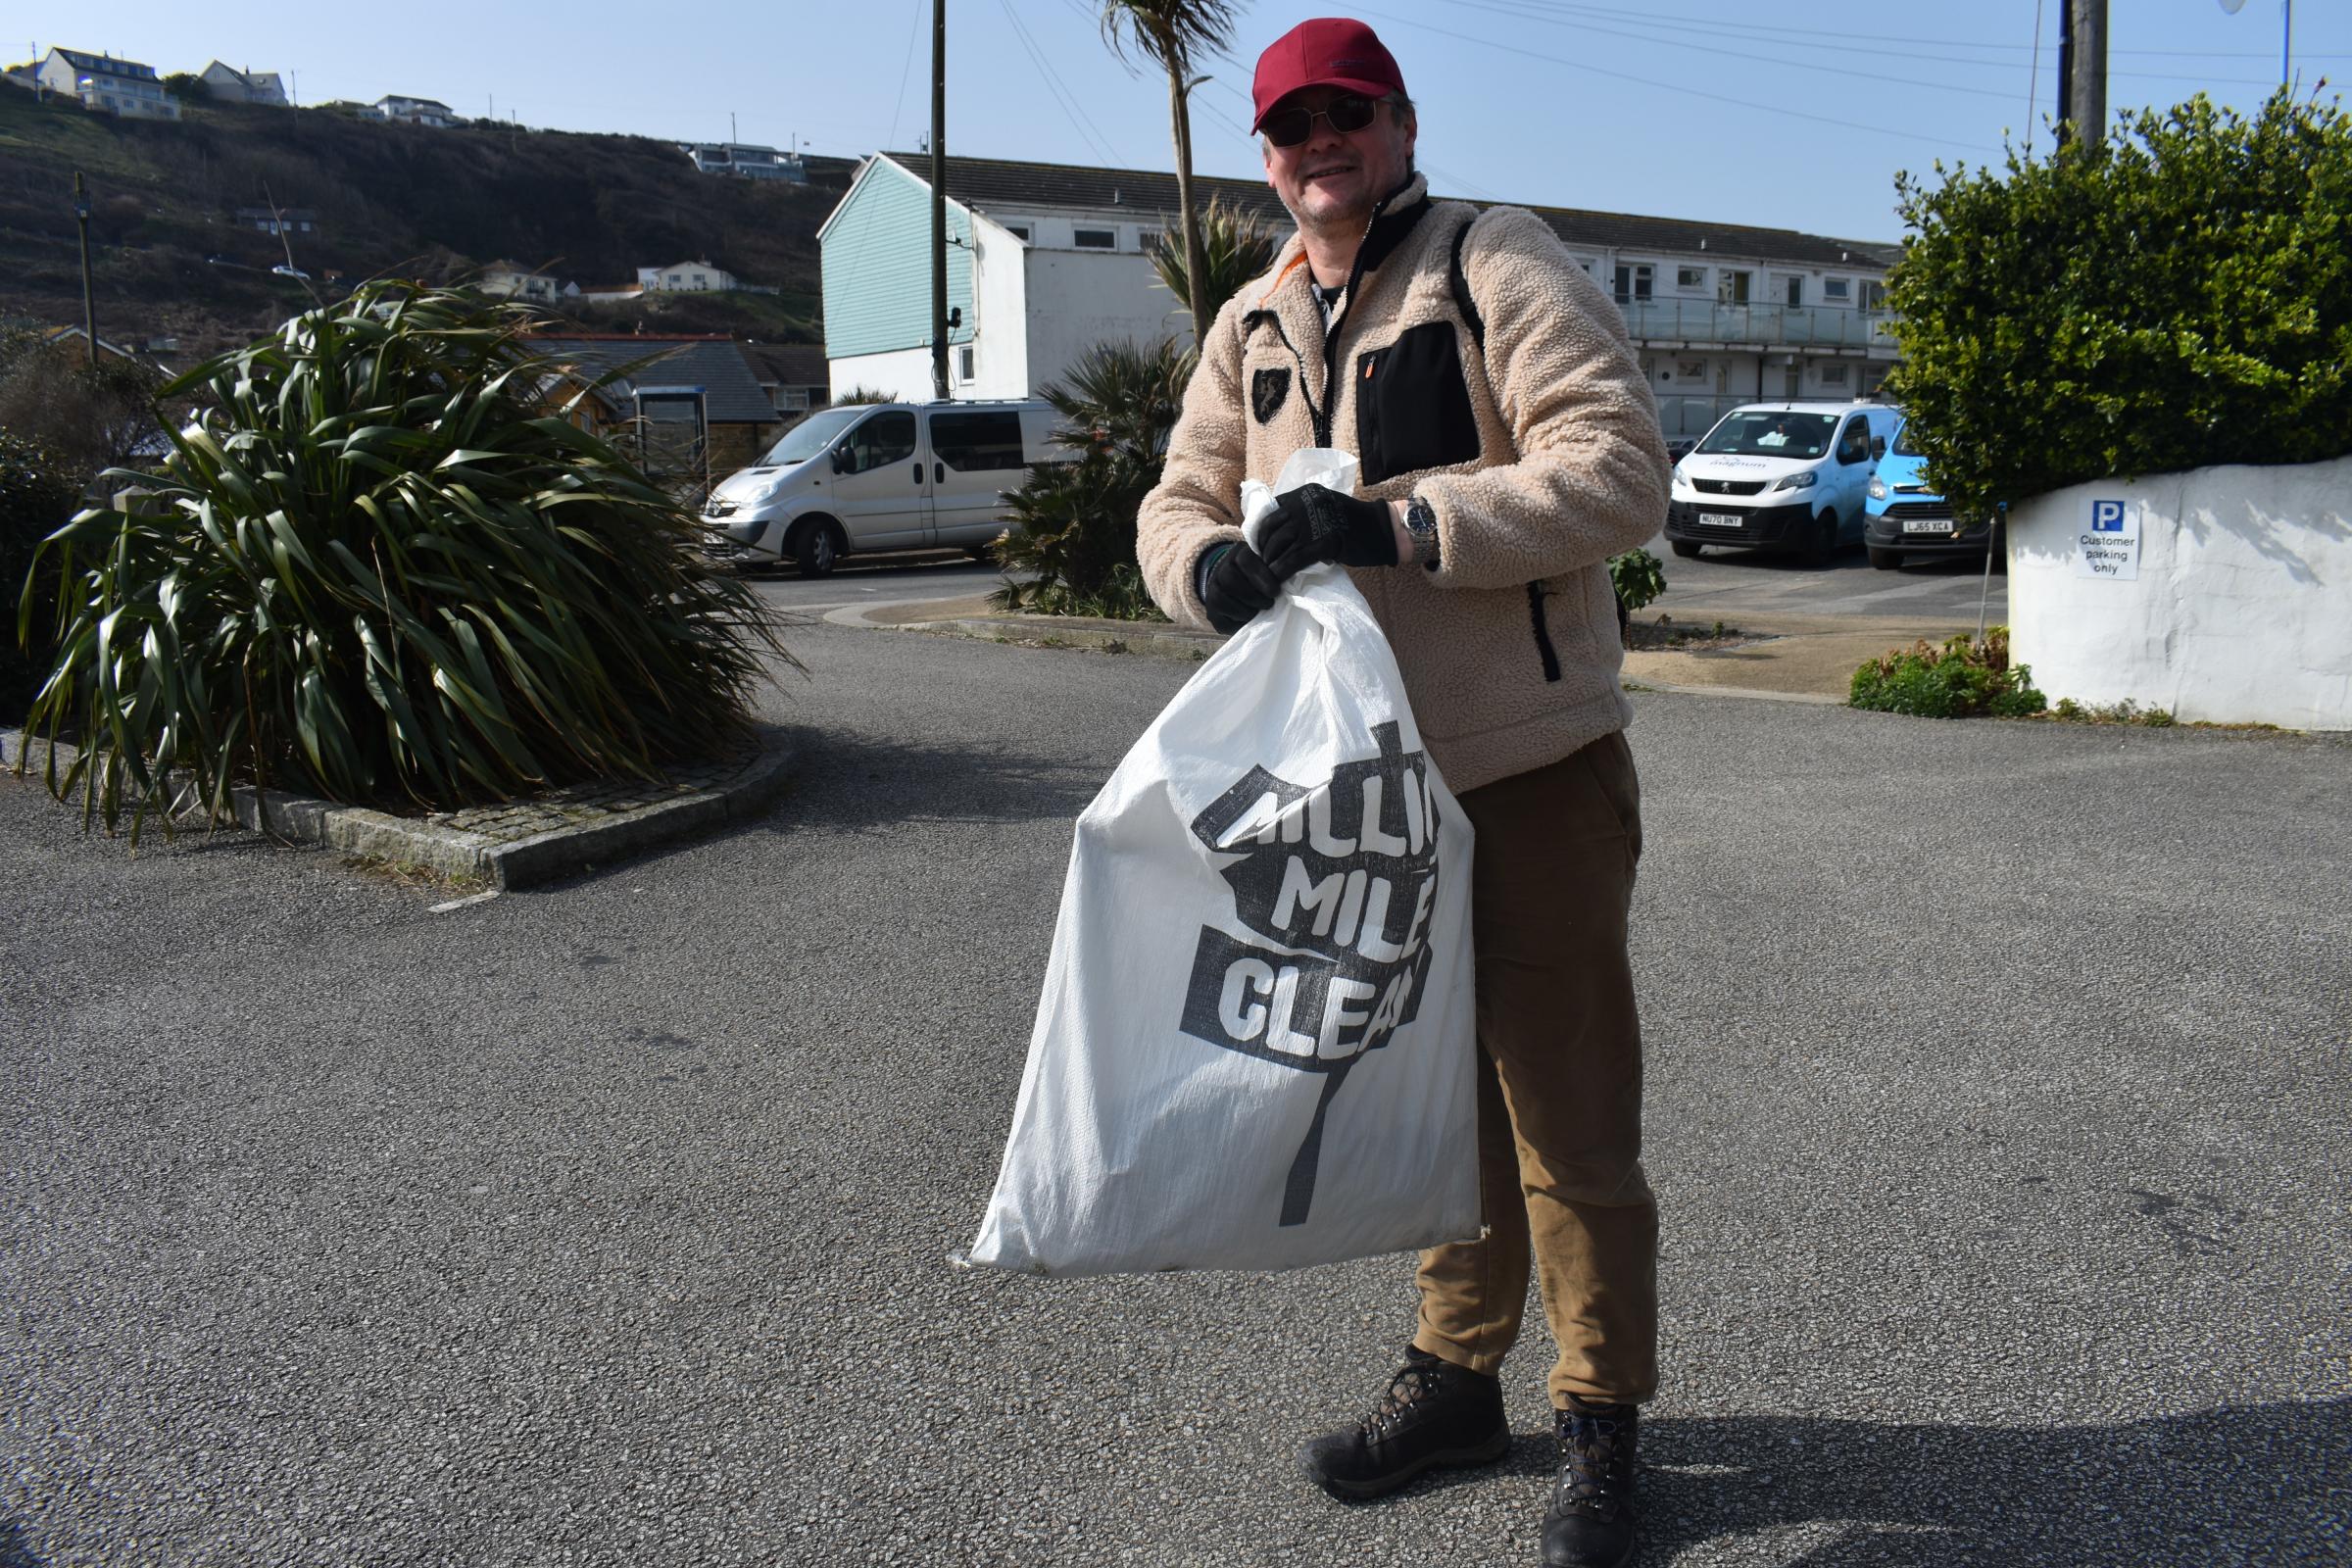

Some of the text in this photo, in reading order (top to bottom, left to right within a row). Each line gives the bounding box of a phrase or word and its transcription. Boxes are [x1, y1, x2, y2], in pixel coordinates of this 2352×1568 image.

[2098, 503, 2120, 529] P
[1907, 521, 1930, 531] LJ65
[2080, 535, 2134, 546] Customer
[2086, 550, 2128, 563] parking
[2093, 564, 2118, 575] only
[1216, 769, 1435, 858] MILLI
[1270, 855, 1437, 964] MILE
